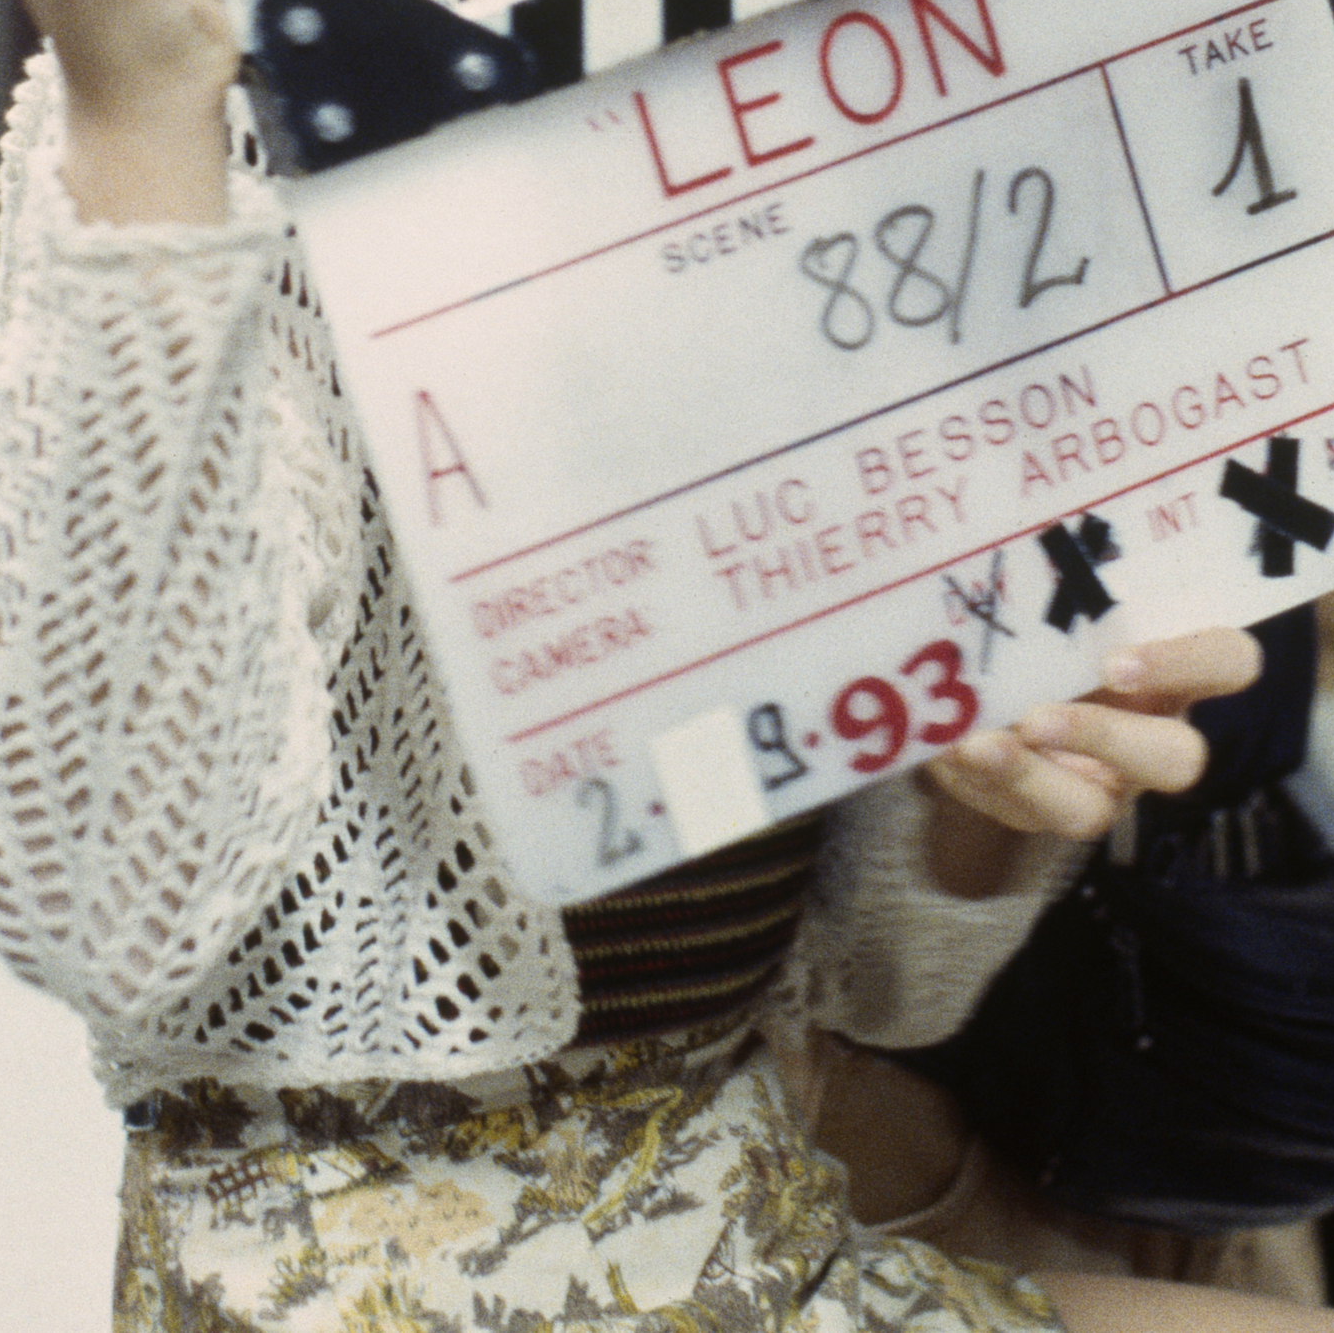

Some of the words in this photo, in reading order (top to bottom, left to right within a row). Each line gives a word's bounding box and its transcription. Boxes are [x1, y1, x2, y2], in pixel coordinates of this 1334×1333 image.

[1177, 17, 1276, 76] TAKE
[1210, 75, 1299, 216] 1
[660, 202, 792, 274] SCENE
[799, 165, 1091, 350] 88/2
[415, 388, 490, 527] A
[470, 537, 655, 640] DIRECTOR
[694, 477, 817, 560] LUC
[853, 364, 1099, 496] BESSON
[486, 606, 653, 697] CAMERA
[711, 479, 969, 613] THIERRY
[1017, 337, 1311, 498] ARBOGAST
[1146, 490, 1199, 544] INT
[517, 727, 627, 799] DATE
